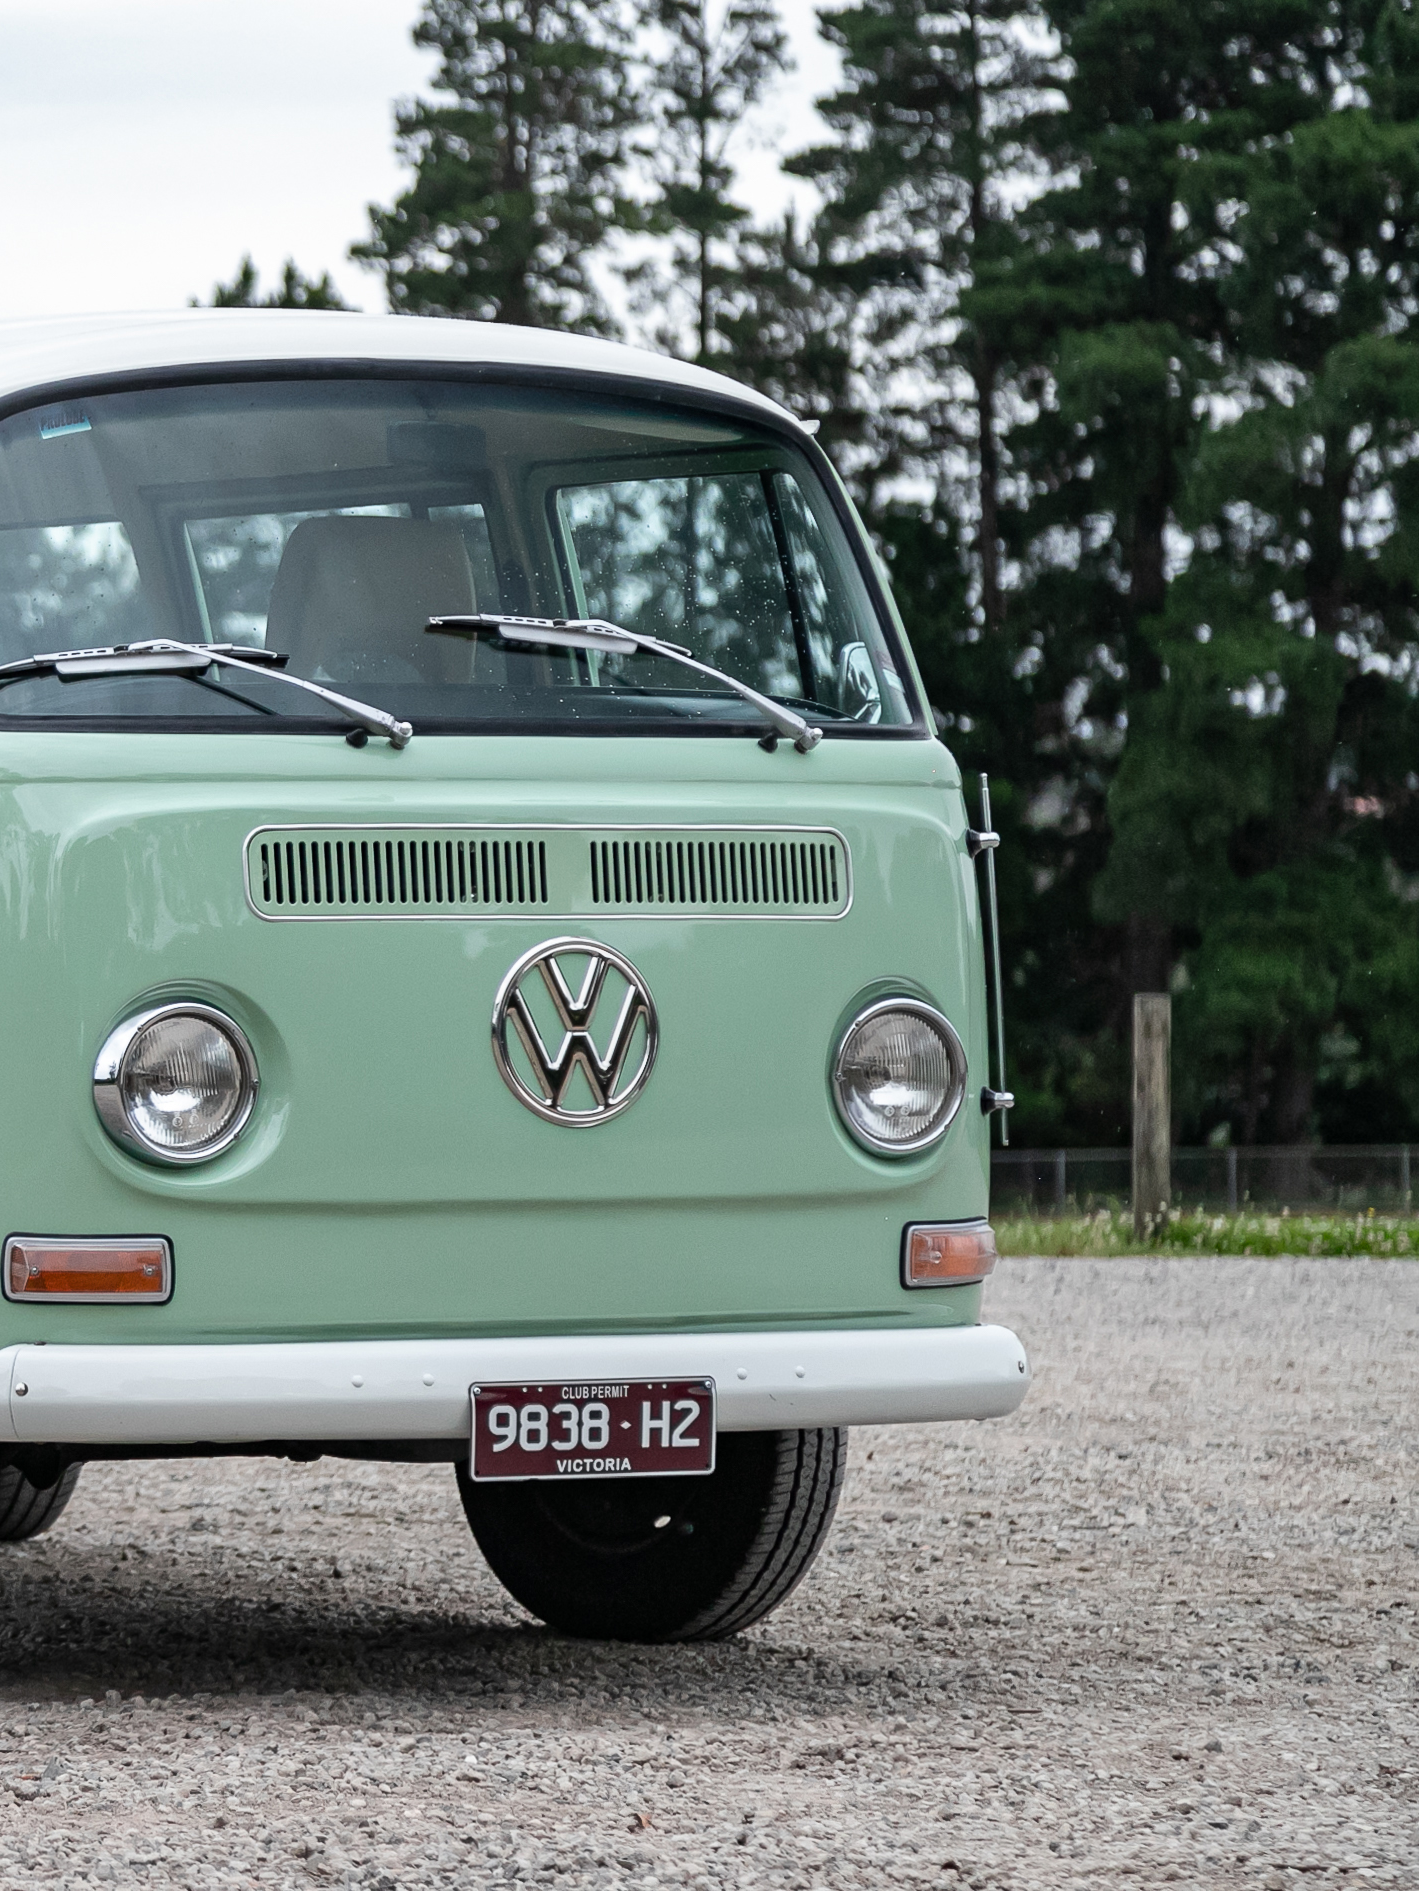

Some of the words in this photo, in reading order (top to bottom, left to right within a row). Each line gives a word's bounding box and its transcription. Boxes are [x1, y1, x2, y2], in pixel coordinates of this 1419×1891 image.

[493, 938, 658, 1127] VW
[561, 1386, 590, 1399] CLUB
[591, 1385, 630, 1398] PERMIT
[488, 1402, 611, 1453] 9838
[641, 1400, 701, 1449] H2
[556, 1457, 632, 1474] VICTORIA
